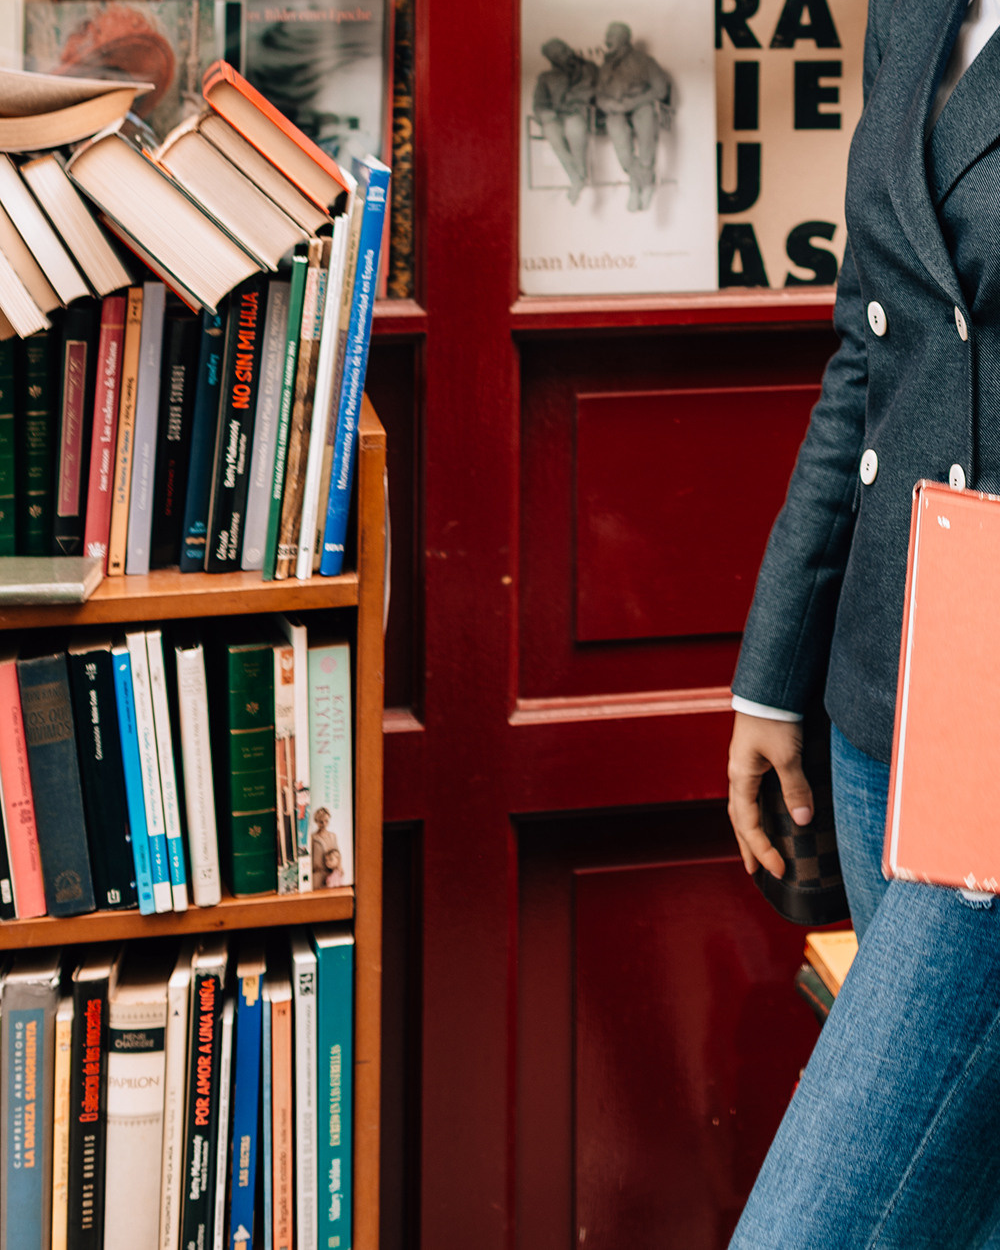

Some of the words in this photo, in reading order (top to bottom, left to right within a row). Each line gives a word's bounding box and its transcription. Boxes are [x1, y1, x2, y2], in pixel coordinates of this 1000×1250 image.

[361, 249, 375, 280] España
[522, 256, 562, 271] uan
[567, 251, 637, 270] Muñoz
[361, 282, 371, 293] en
[240, 292, 259, 328] HIJA
[353, 294, 369, 344] Humanidad
[238, 330, 256, 351] MI
[351, 345, 363, 355] la
[234, 353, 254, 383] SIN
[350, 355, 362, 367] de
[232, 384, 251, 409] NO
[344, 368, 362, 417] Patrimonio
[344, 417, 355, 431] del
[336, 432, 354, 490] Monumentos
[315, 685, 331, 755] FLYNN
[332, 694, 345, 741] KATIE
[199, 978, 215, 1011] NIÑA
[83, 999, 102, 1046] inocentes
[123, 1032, 146, 1041] HENRI
[199, 1012, 213, 1042] UNA
[14, 1021, 23, 1099] ARMSTRONG
[25, 1020, 37, 1100] SANGRIENTA
[83, 1047, 101, 1062] los
[198, 1043, 212, 1054] A
[83, 1063, 100, 1075] de
[109, 1076, 160, 1088] PAPILLON
[196, 1055, 212, 1096] AMOR
[81, 1076, 100, 1112] silencio
[25, 1102, 36, 1149] DANZA
[79, 1112, 99, 1123] El
[195, 1097, 210, 1126] POR
[13, 1105, 22, 1169] CAMPBELL
[239, 1135, 251, 1168] SECTAS
[24, 1150, 35, 1168] LA
[279, 1152, 287, 1182] extraño
[238, 1169, 249, 1188] LAS
[280, 1183, 287, 1194] un
[279, 1197, 289, 1225] llegado
[279, 1226, 287, 1238] Ha
